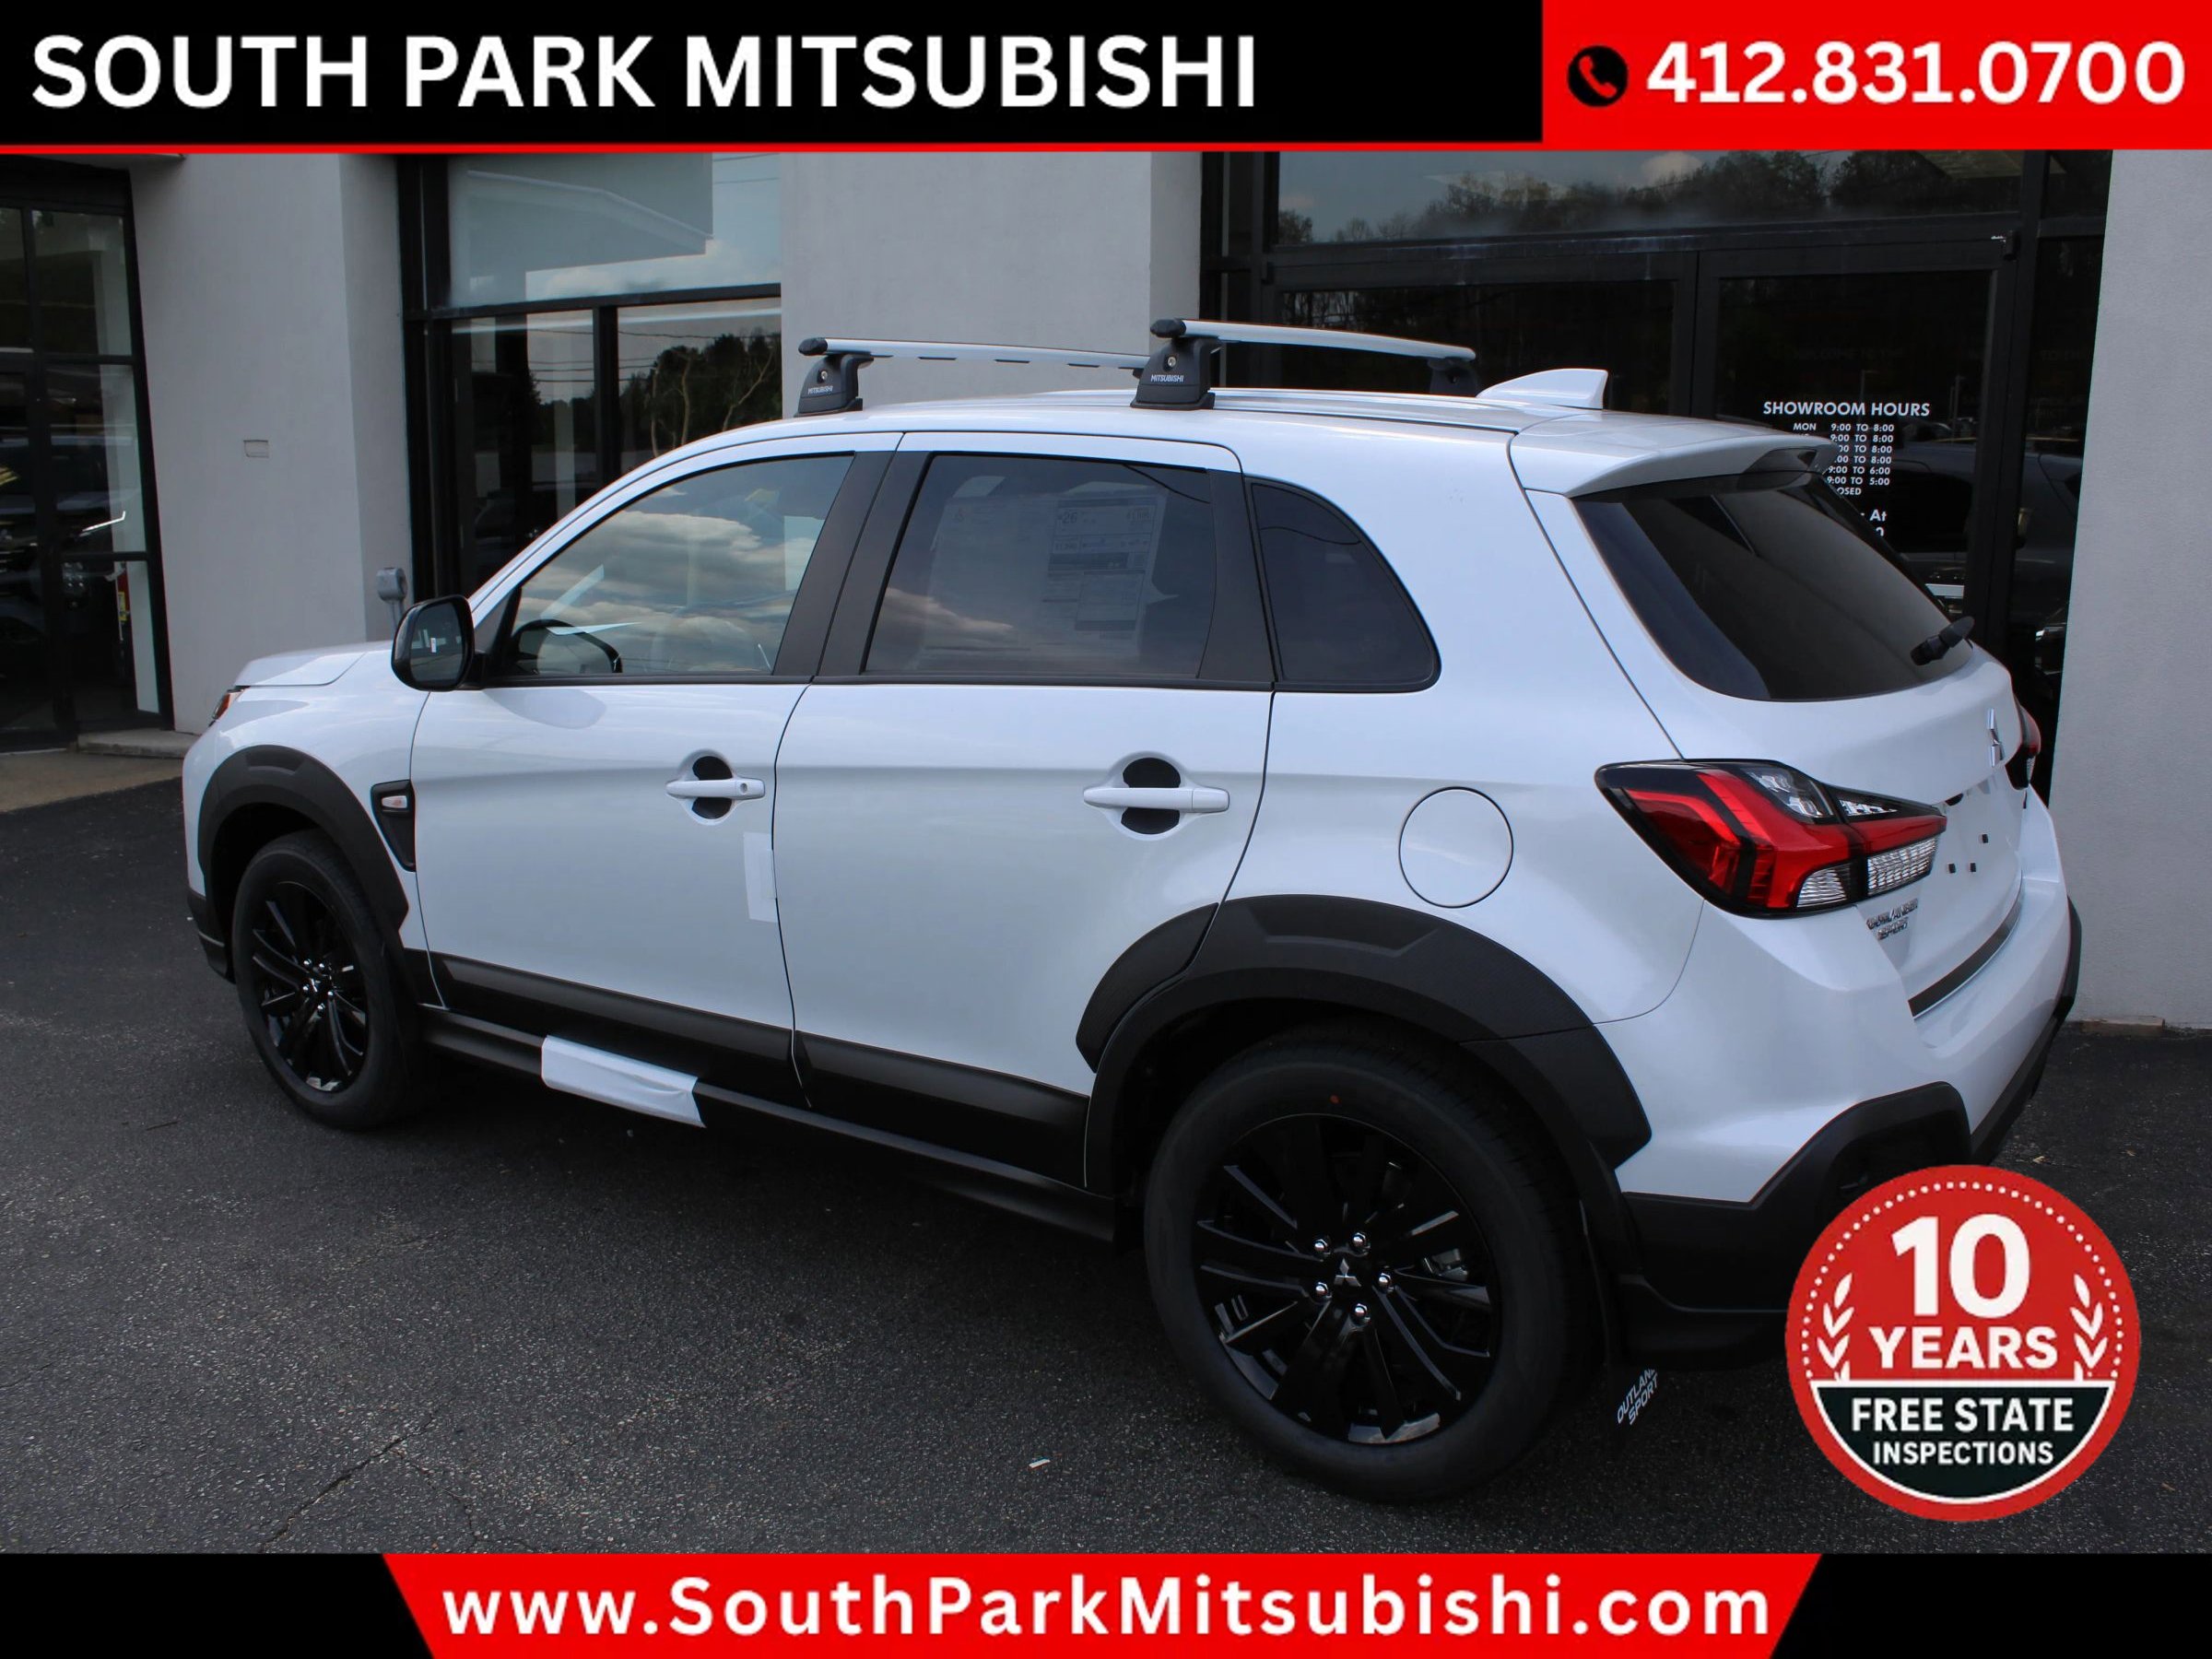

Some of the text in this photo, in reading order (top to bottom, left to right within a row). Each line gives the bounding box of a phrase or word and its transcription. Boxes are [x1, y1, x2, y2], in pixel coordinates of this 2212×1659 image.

[1150, 374, 1184, 382] MITSUBISHI
[1763, 401, 1930, 417] SHOWROOM HOURS
[1793, 422, 1894, 432] MON 9:00 TO 8:00
[1854, 434, 1867, 442] TO
[1854, 455, 1866, 464] TO
[1853, 466, 1865, 475] TO
[1837, 487, 1862, 496] OSED
[1869, 509, 1887, 522] At
[1629, 1372, 1658, 1426] SPORT
